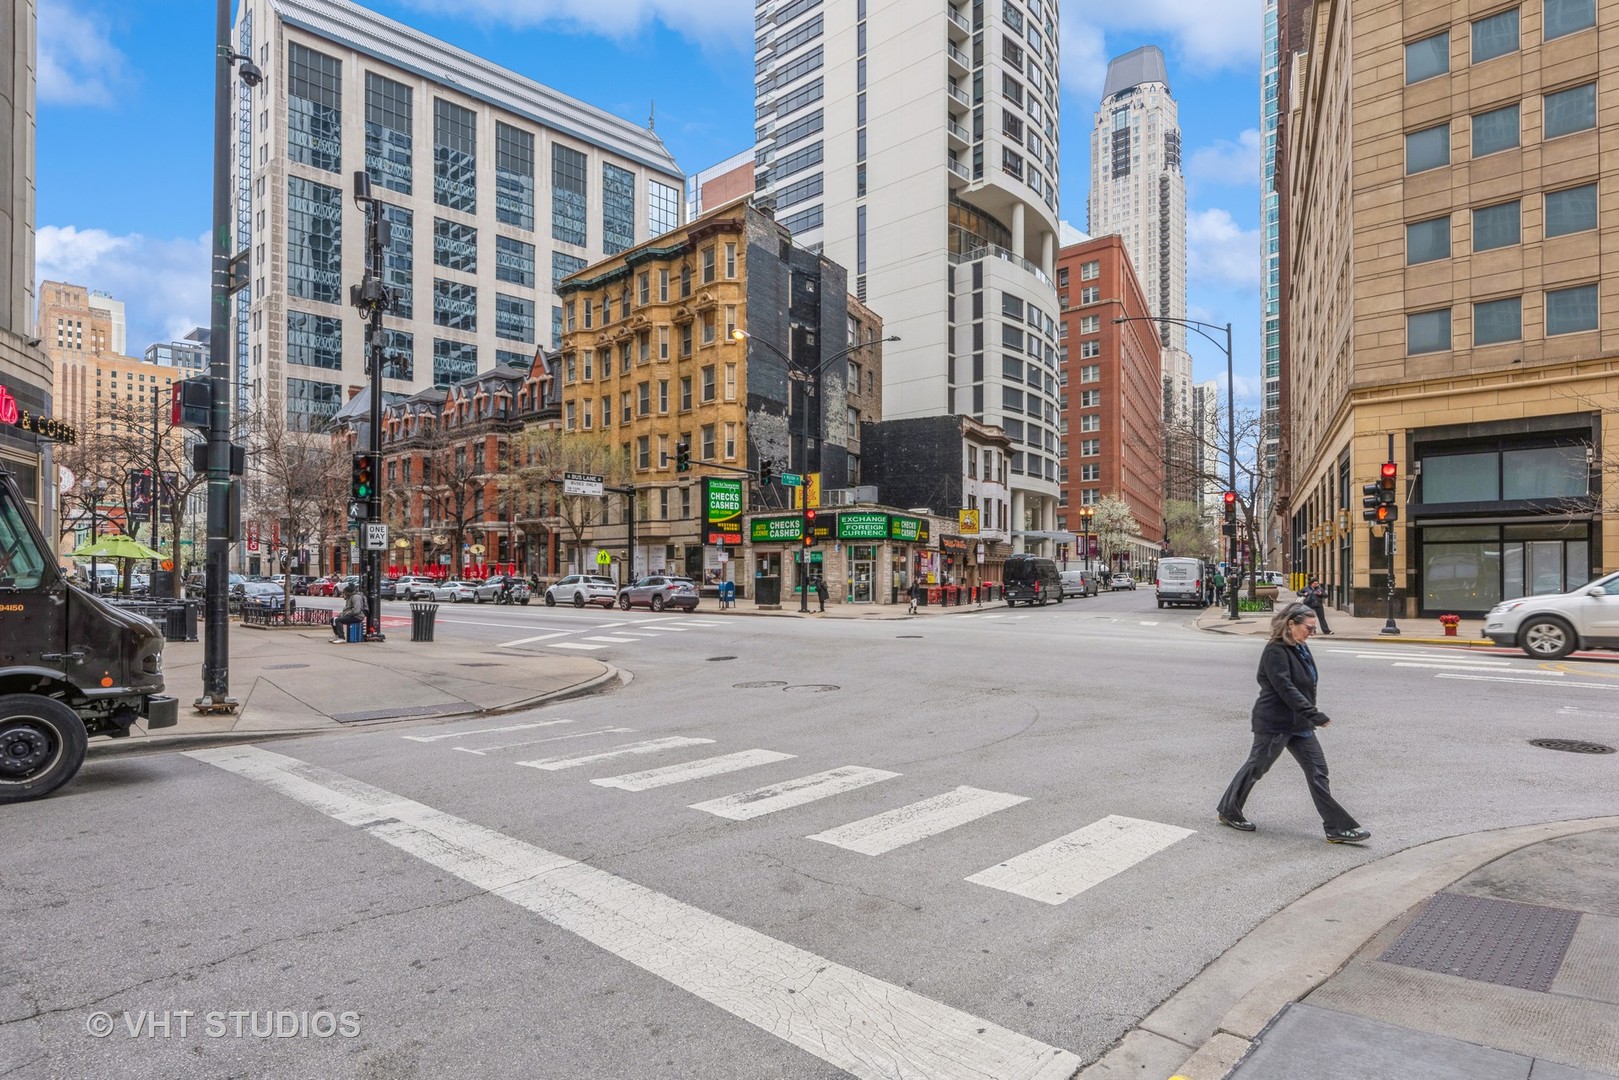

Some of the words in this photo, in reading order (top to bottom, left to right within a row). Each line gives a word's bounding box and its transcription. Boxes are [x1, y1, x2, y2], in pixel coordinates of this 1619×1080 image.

[22, 409, 31, 430] &
[710, 492, 739, 501] CHECKS
[710, 501, 740, 510] CASHED
[770, 520, 800, 529] CHECKS
[901, 520, 916, 529] CHECKS
[770, 529, 800, 538] CASHED
[901, 529, 916, 538] CASHED
